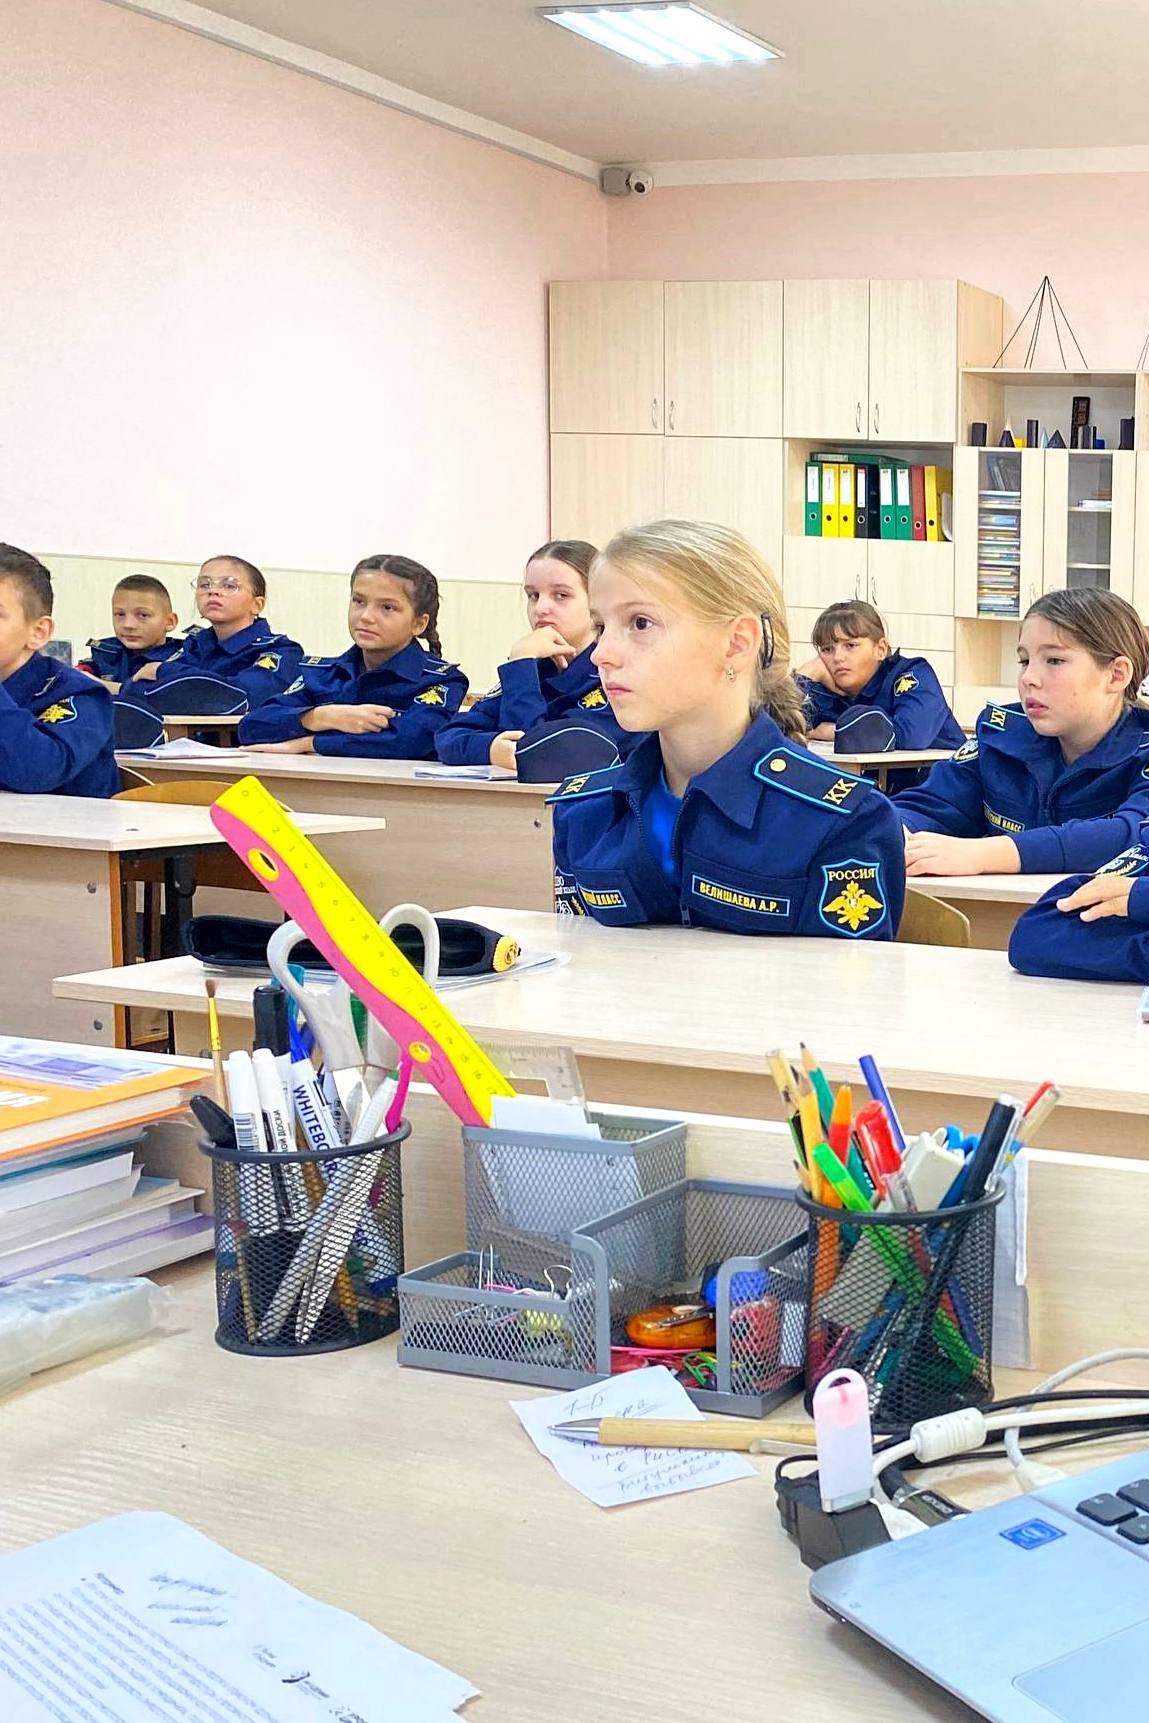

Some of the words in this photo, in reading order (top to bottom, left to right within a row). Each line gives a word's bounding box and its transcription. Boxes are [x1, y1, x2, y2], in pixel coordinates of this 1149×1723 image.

[823, 778, 858, 806] КК
[828, 868, 876, 881] РОССИЯ
[699, 882, 757, 910] ВЕЛИШАЕВА
[759, 900, 780, 913] А.Р.
